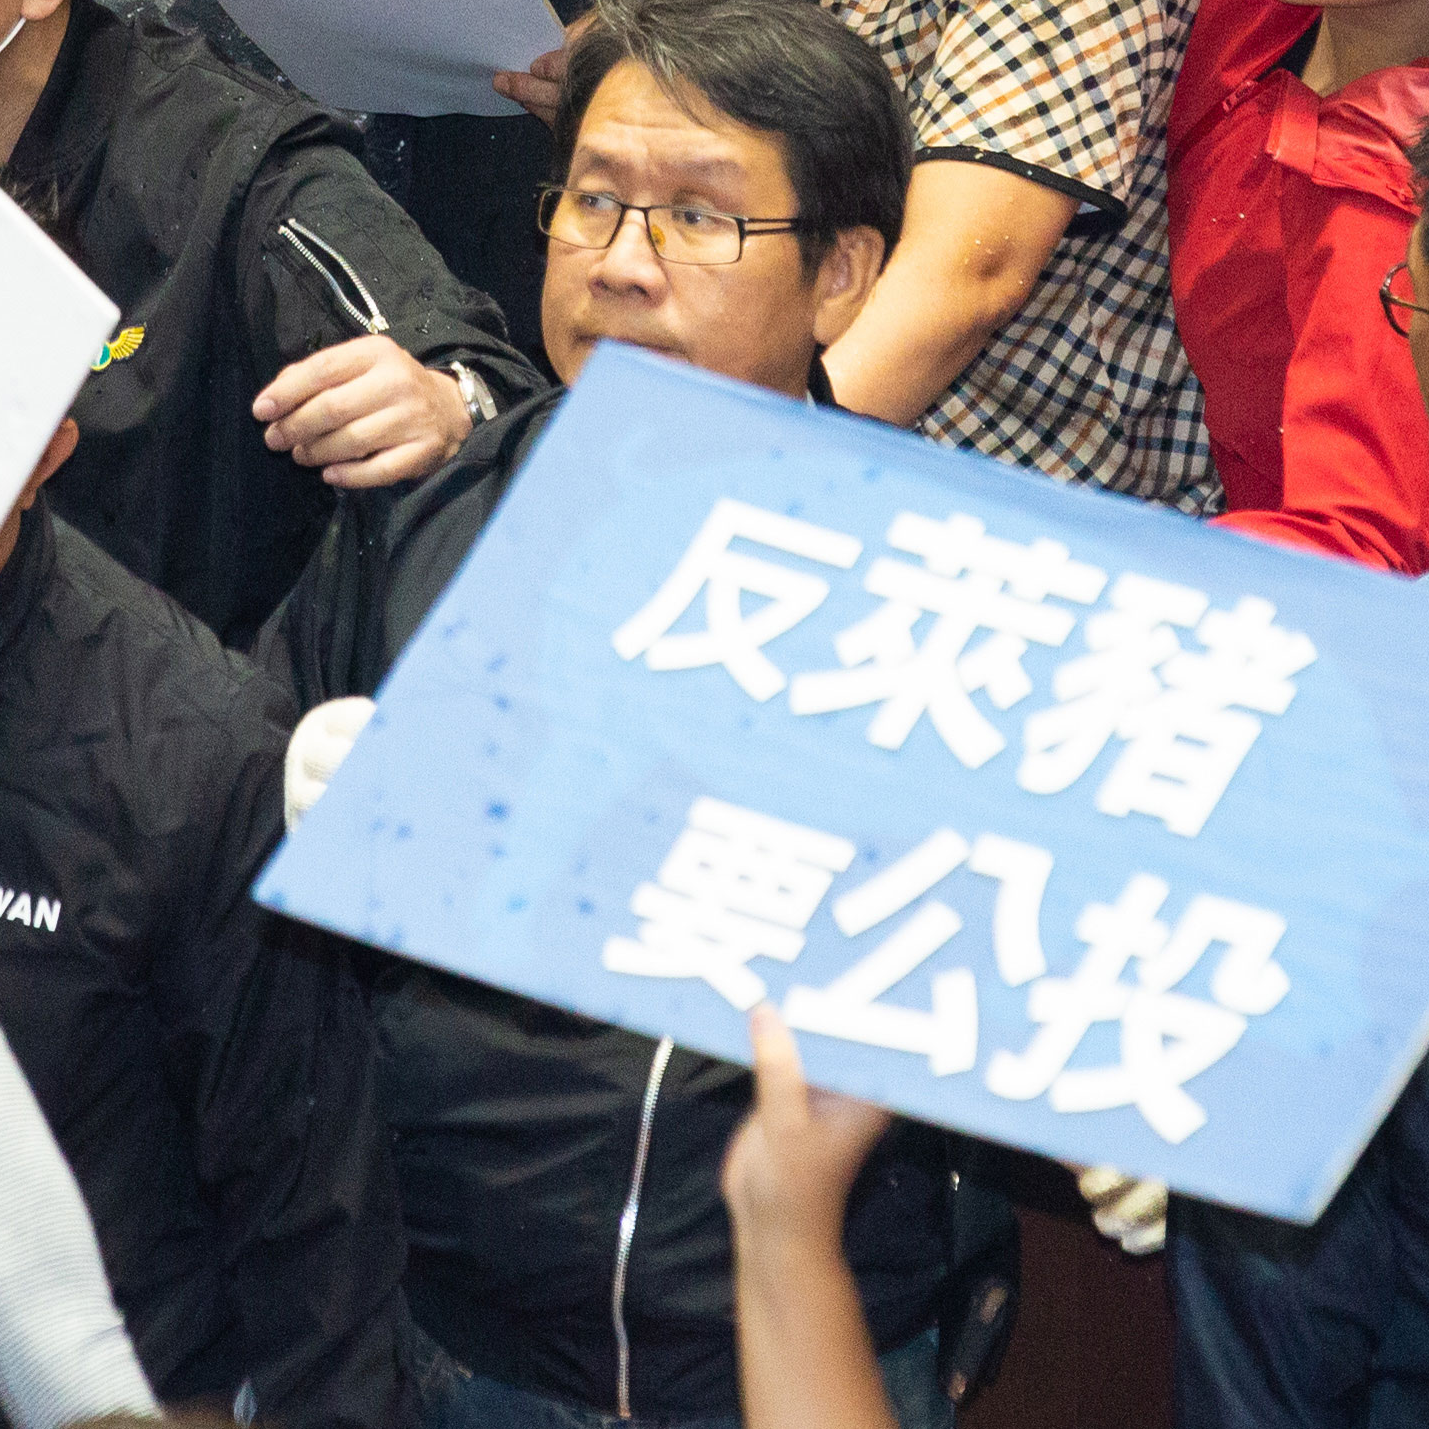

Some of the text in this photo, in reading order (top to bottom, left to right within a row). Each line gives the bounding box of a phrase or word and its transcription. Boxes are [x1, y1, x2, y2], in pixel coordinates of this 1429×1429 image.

[611, 496, 1318, 840] 反萊豬
[602, 796, 1291, 1146] 要公投
